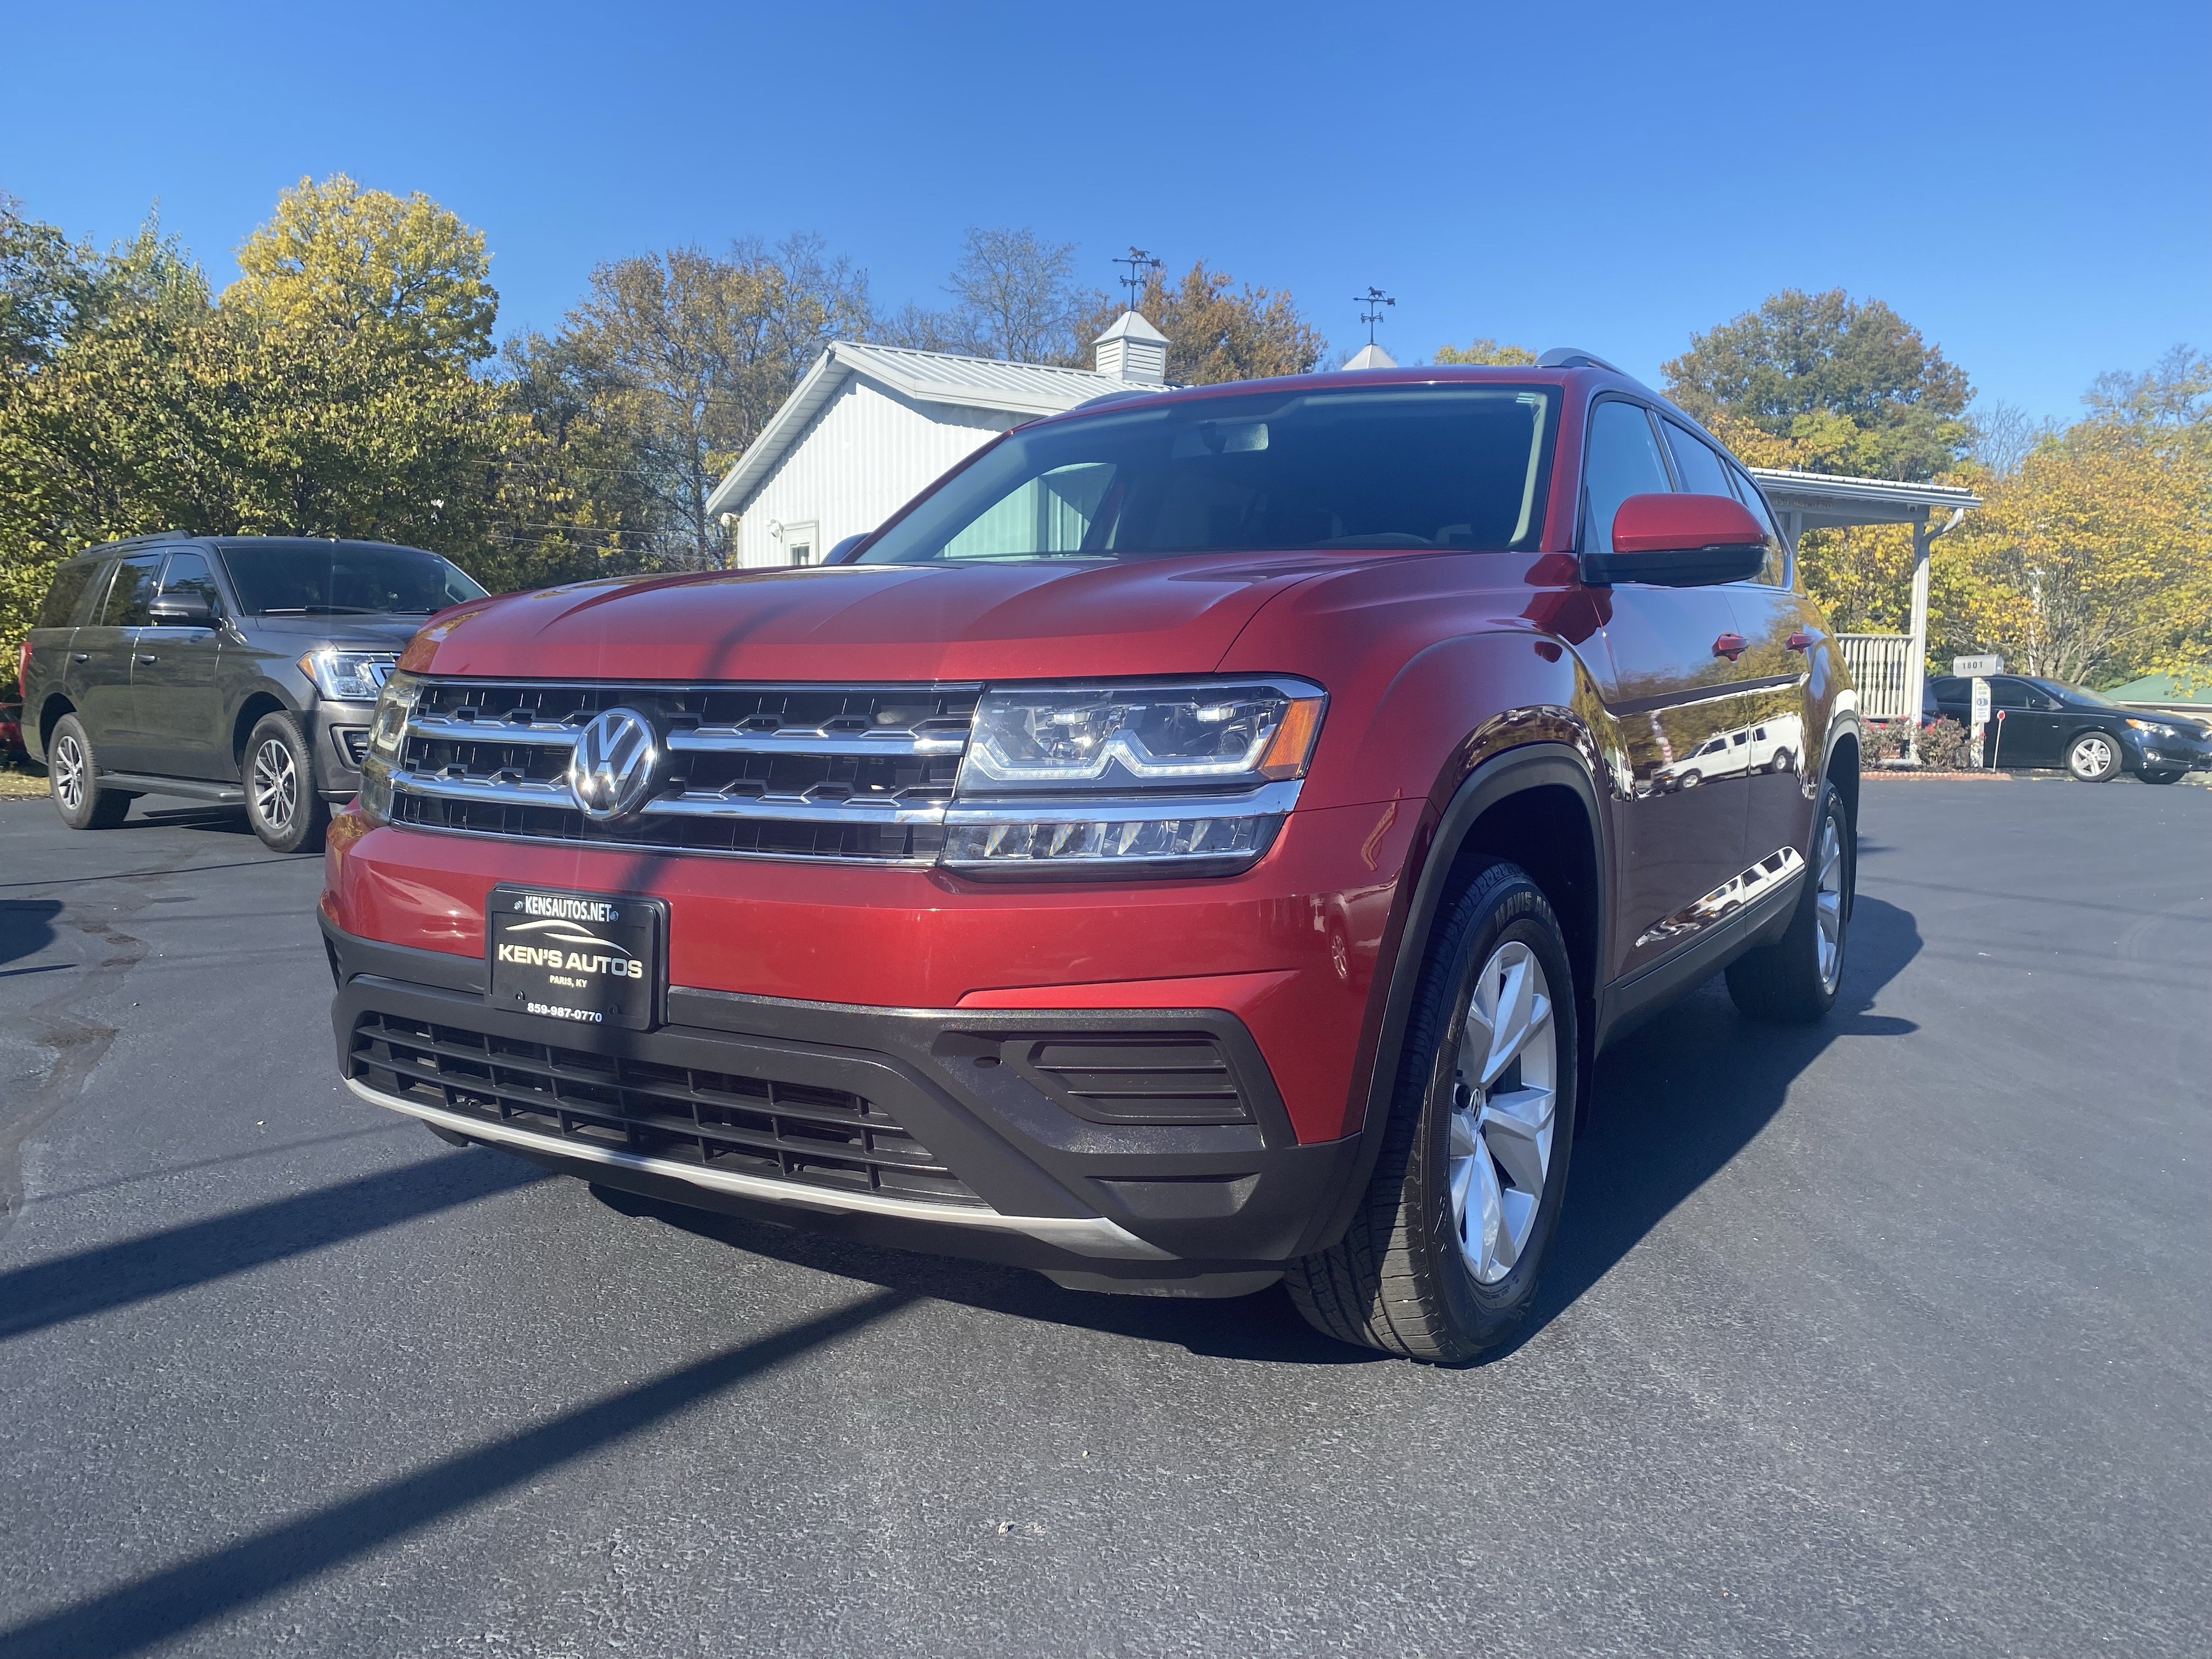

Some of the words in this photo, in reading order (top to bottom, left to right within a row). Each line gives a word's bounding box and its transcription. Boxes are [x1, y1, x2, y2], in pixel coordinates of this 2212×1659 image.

[1962, 661, 1983, 669] 1801
[526, 895, 612, 922] KENSAUTOS.NET
[1494, 891, 1532, 933] MAVIS
[498, 943, 562, 968] KEN'S
[565, 952, 642, 979] AUTOS
[549, 974, 574, 988] PARIS,
[575, 978, 588, 988] KY
[527, 1002, 602, 1022] 859-987-0770
